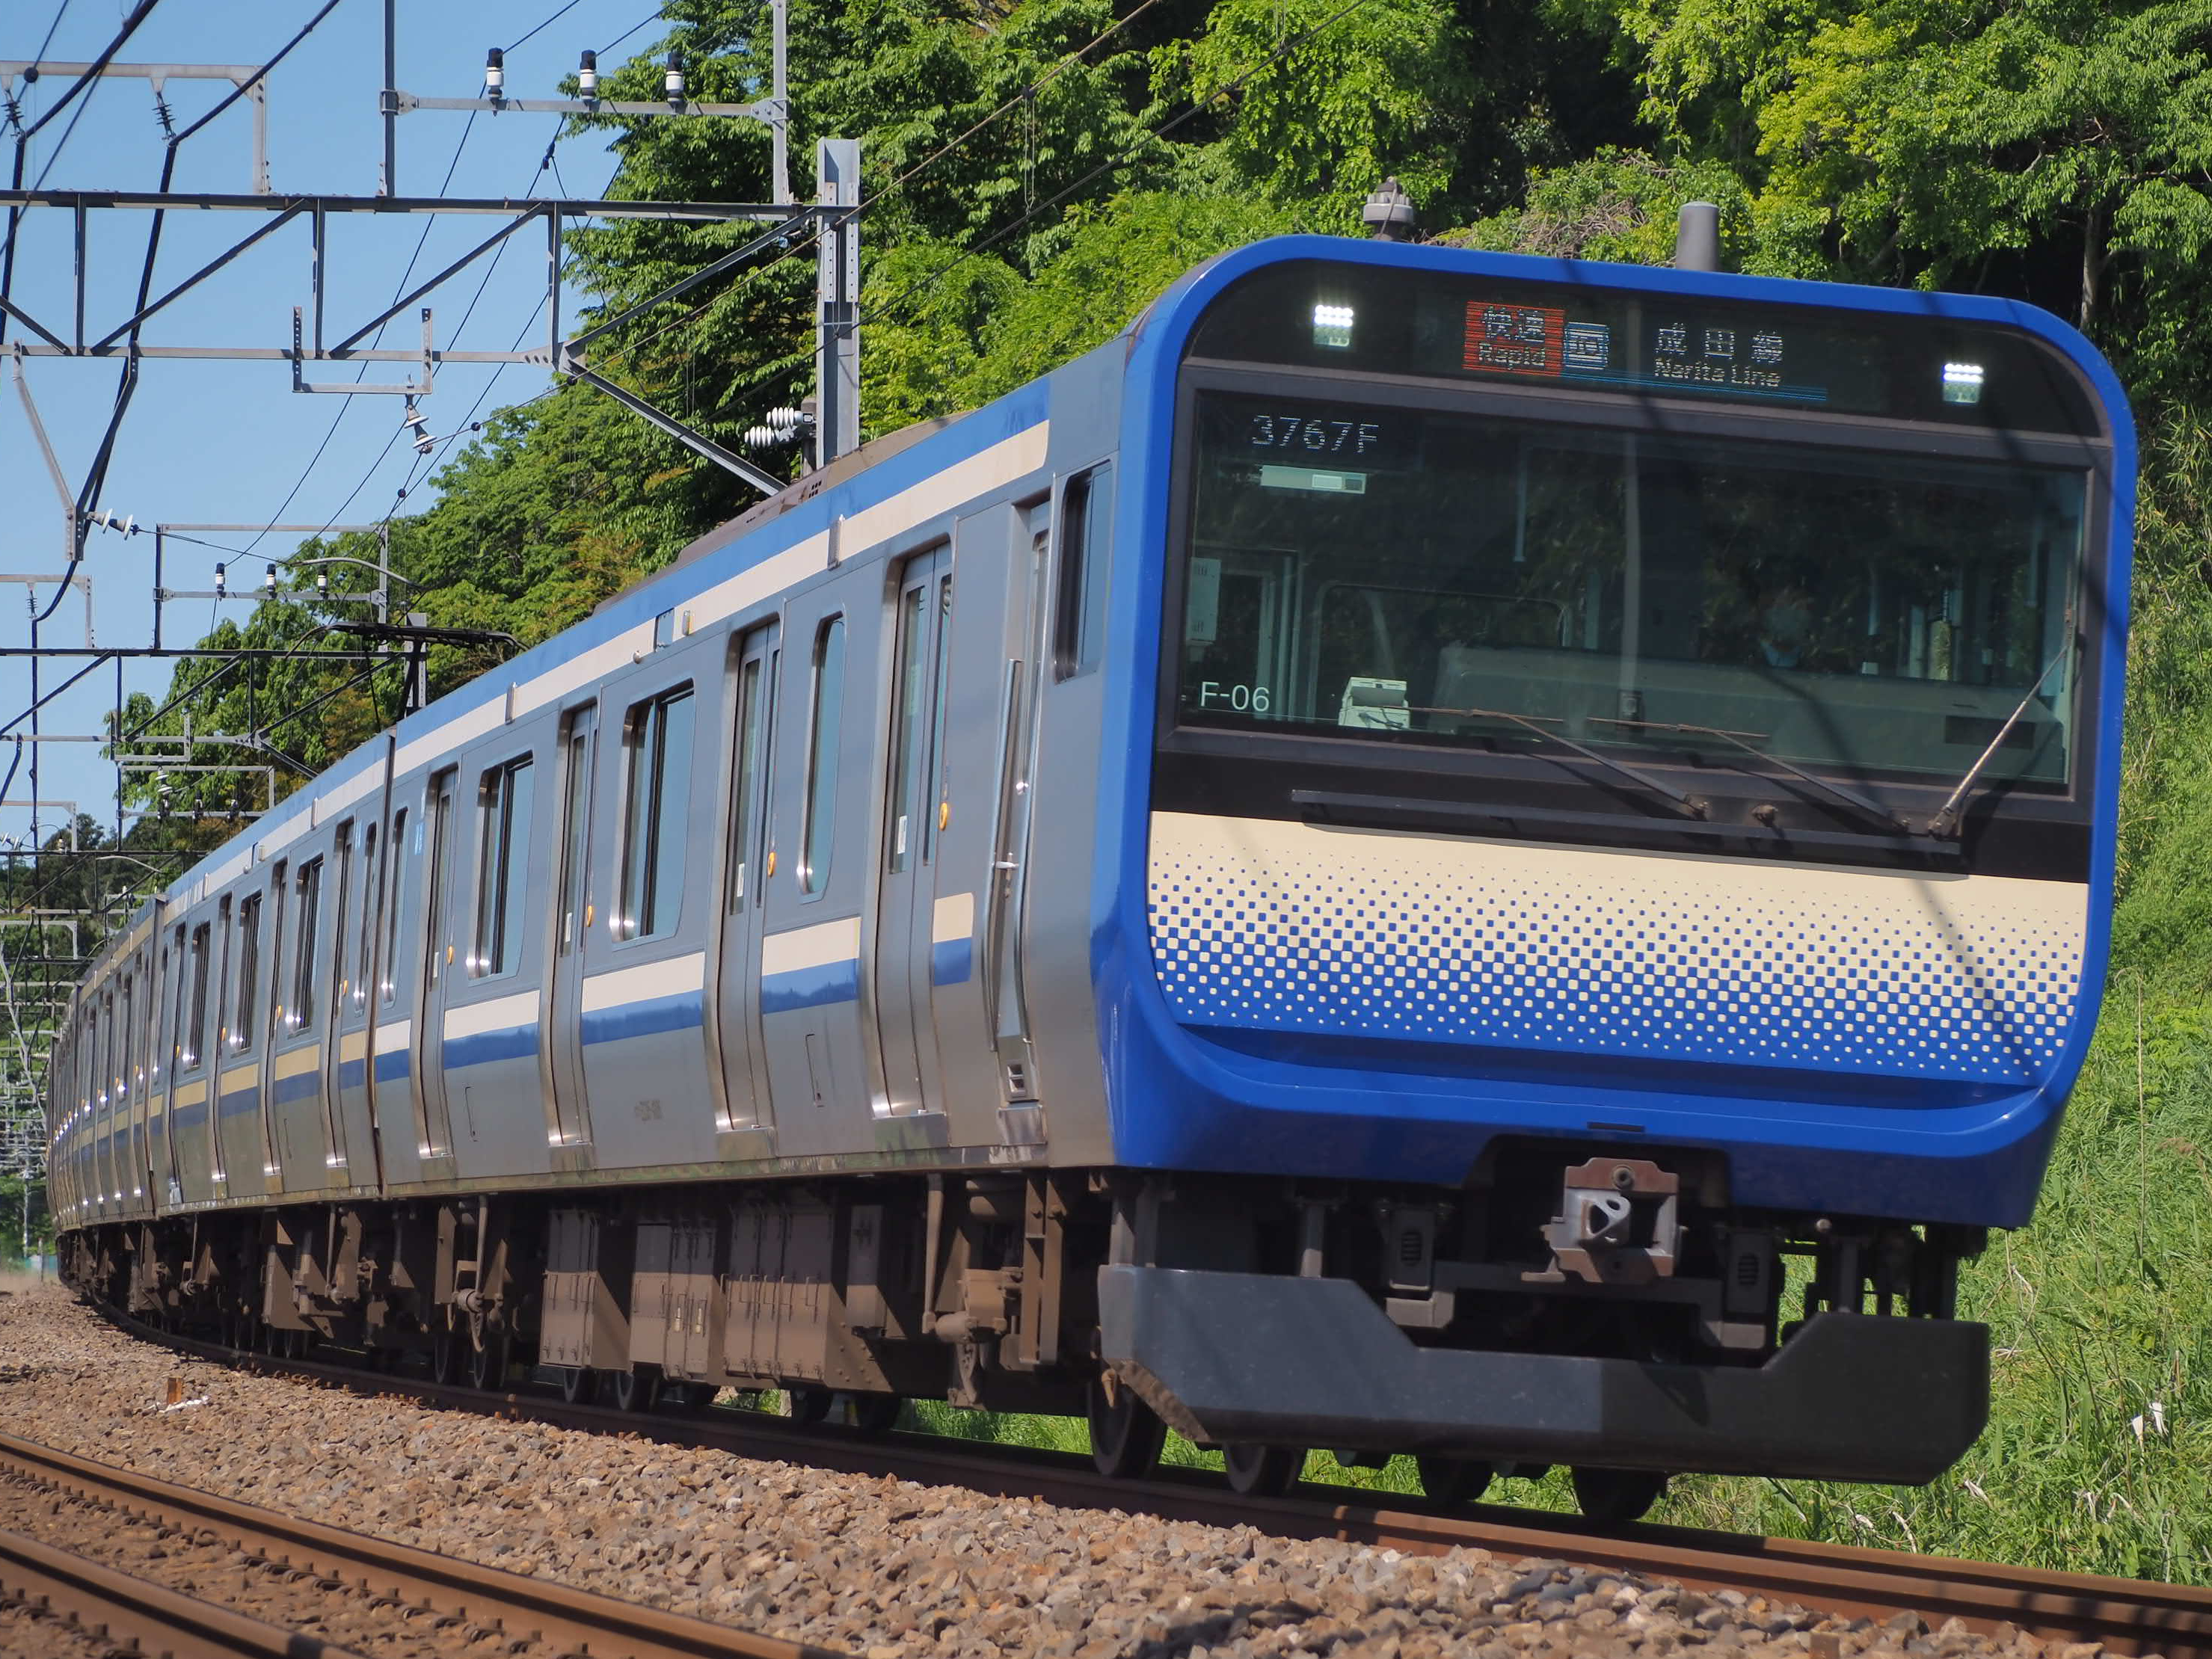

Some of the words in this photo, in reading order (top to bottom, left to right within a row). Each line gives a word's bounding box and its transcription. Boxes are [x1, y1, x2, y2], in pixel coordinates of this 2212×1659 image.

[1482, 306, 1546, 343] 快速
[1478, 342, 1546, 371] Rapid
[1655, 322, 1784, 364] 成田線
[1655, 357, 1725, 382] Narita
[1731, 364, 1781, 387] Line
[1252, 415, 1380, 453] 3767F
[1200, 681, 1271, 712] F-06
